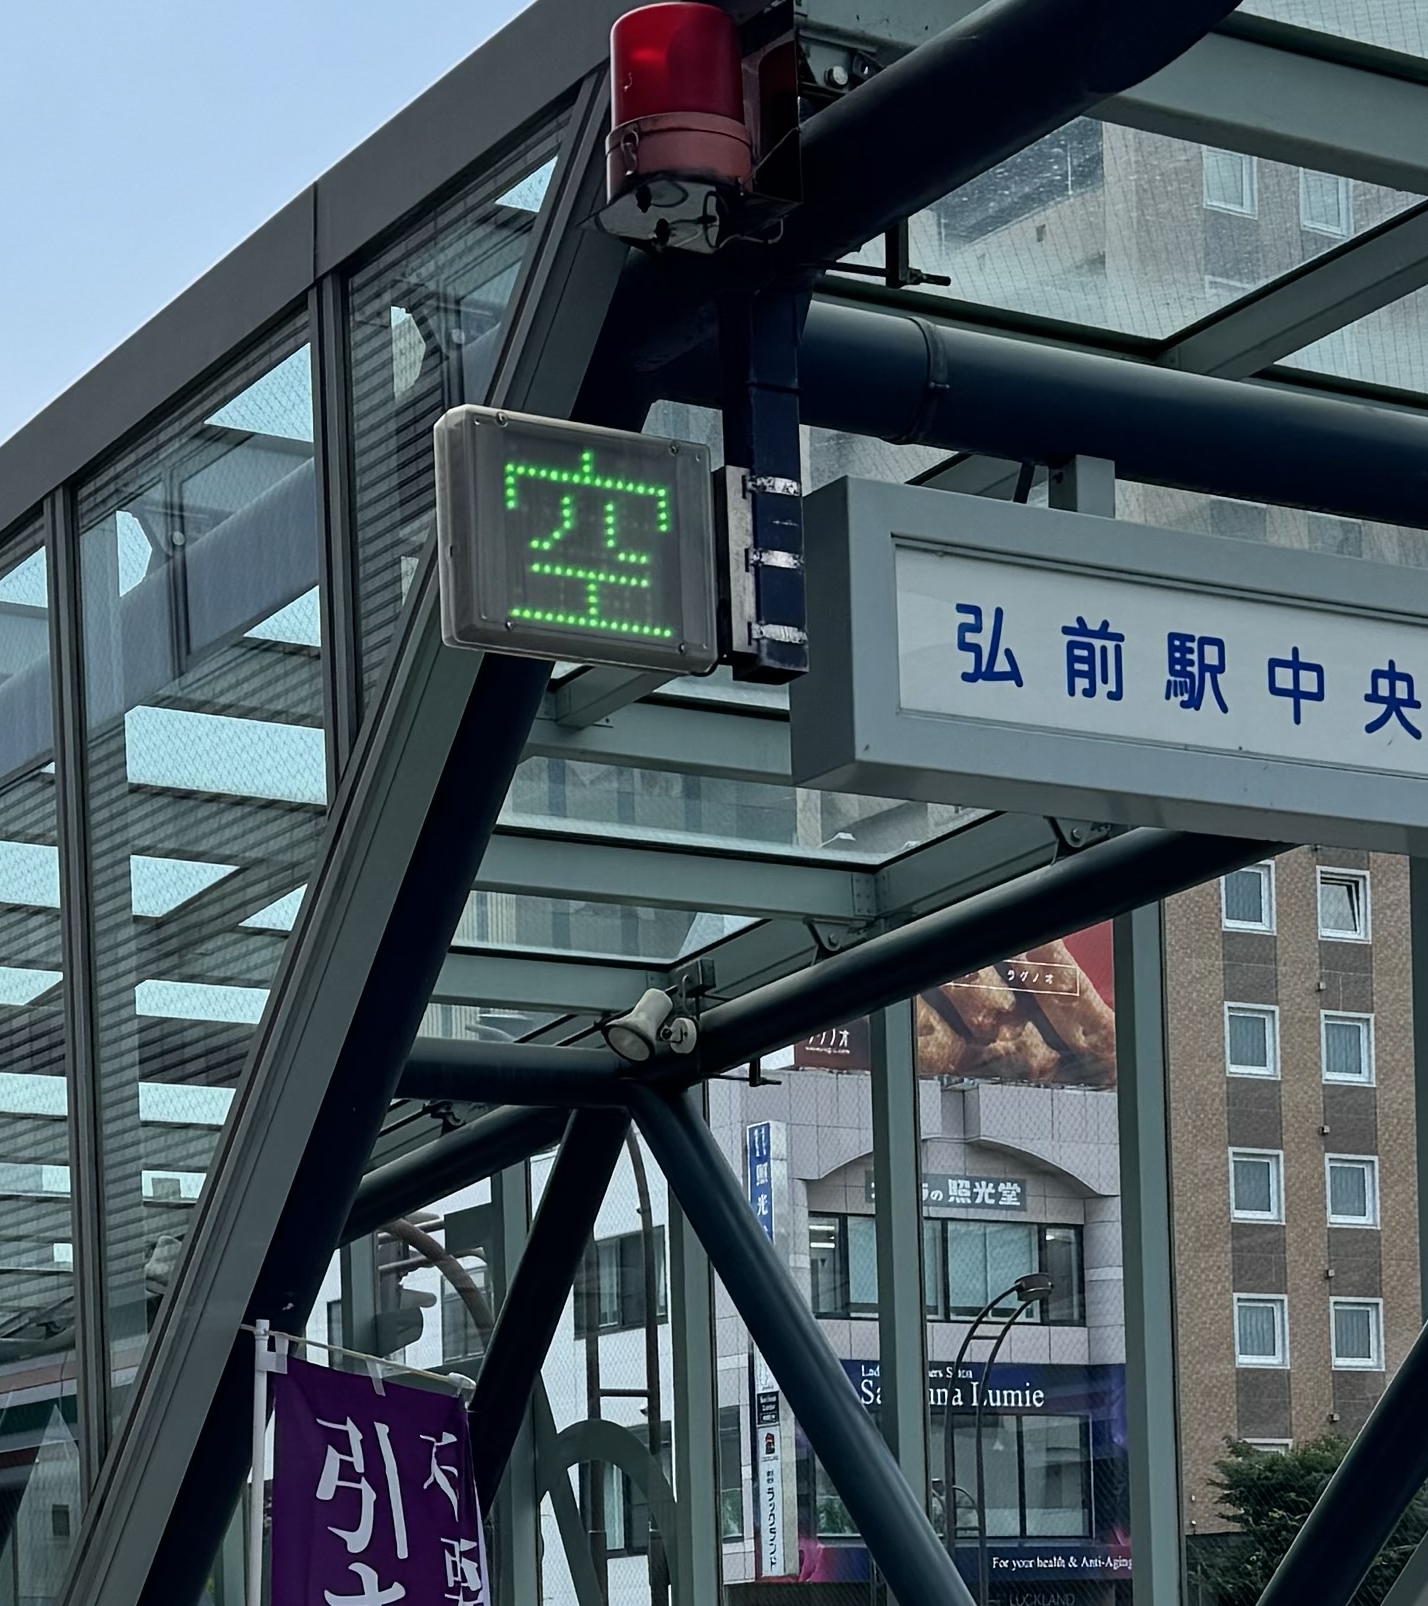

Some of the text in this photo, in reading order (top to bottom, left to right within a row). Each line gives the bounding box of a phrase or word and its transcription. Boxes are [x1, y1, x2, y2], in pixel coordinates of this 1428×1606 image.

[506, 449, 672, 639] 空
[992, 1556, 1009, 1569] For
[1012, 1558, 1034, 1572] your
[1037, 1555, 1065, 1569] health
